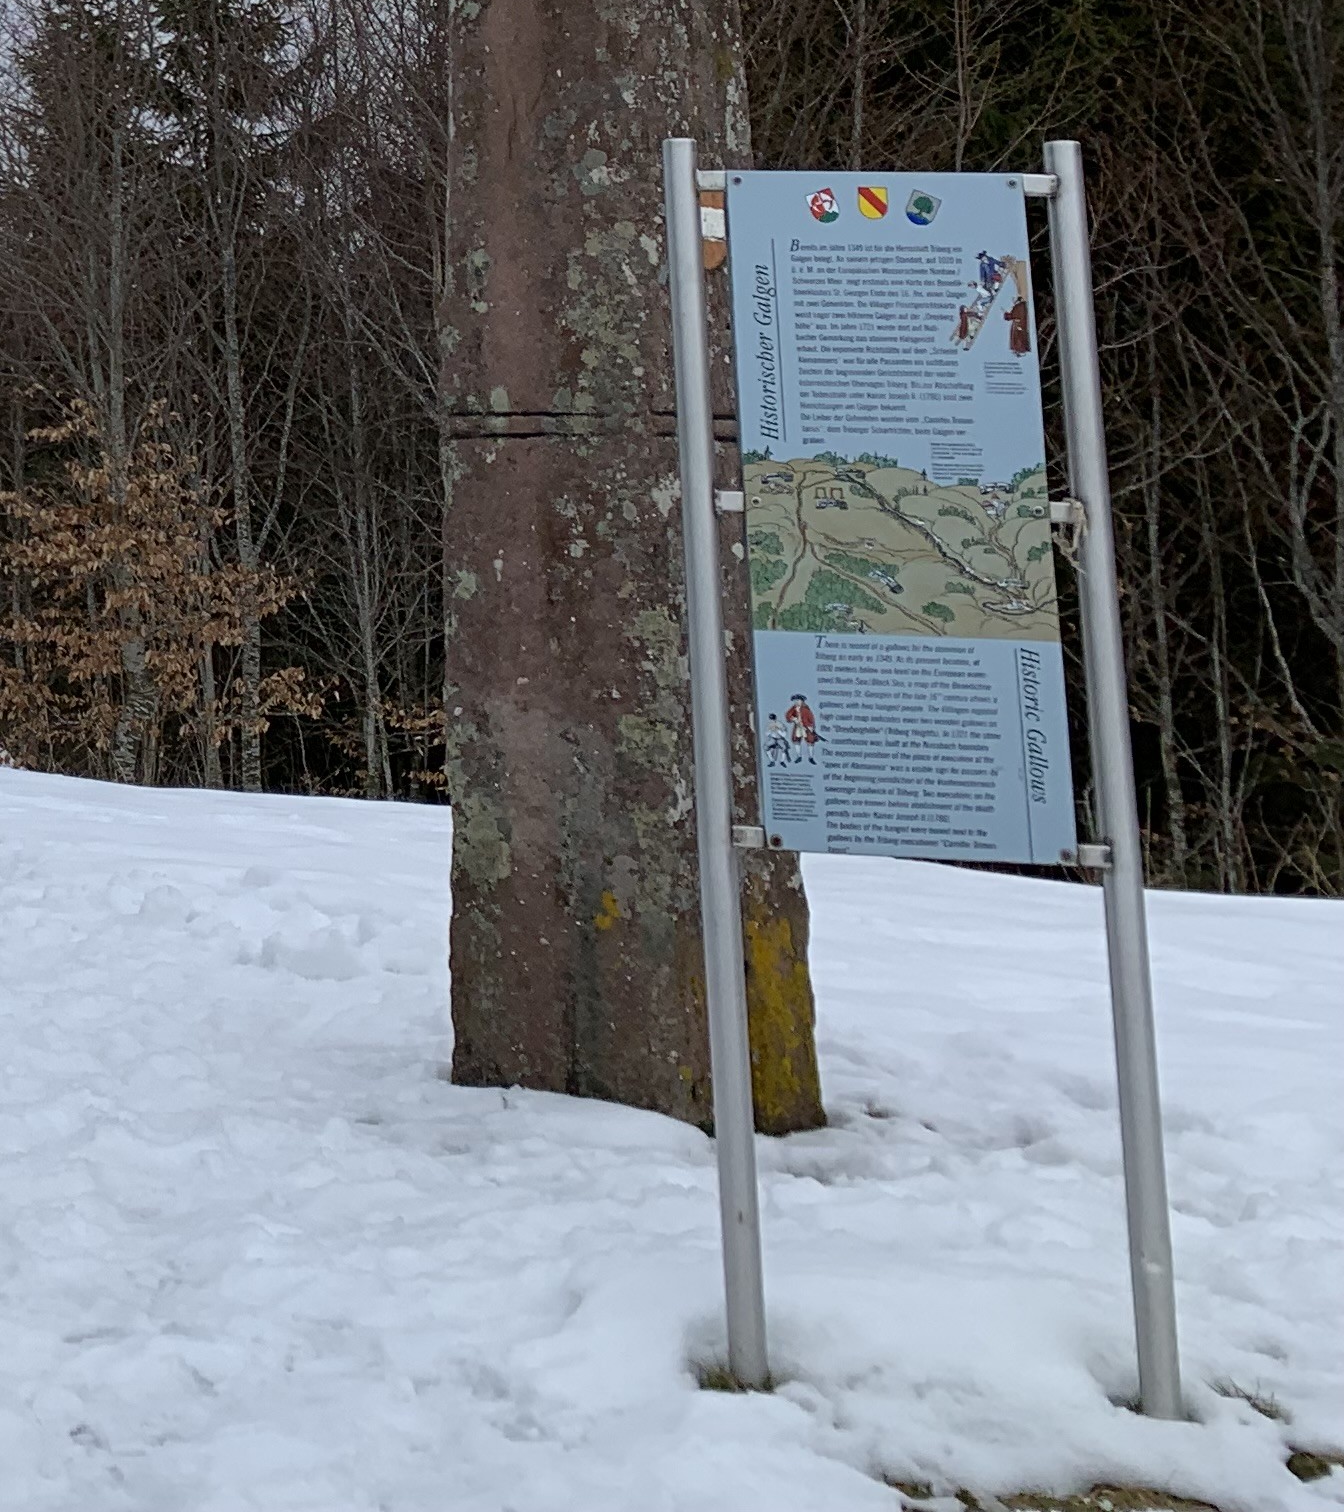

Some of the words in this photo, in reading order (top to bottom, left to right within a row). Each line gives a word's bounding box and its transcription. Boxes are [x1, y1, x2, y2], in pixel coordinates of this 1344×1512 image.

[752, 264, 777, 326] Galgen
[754, 332, 779, 439] Historischer
[1020, 647, 1045, 722] Historic
[1026, 728, 1050, 805] Gallows
